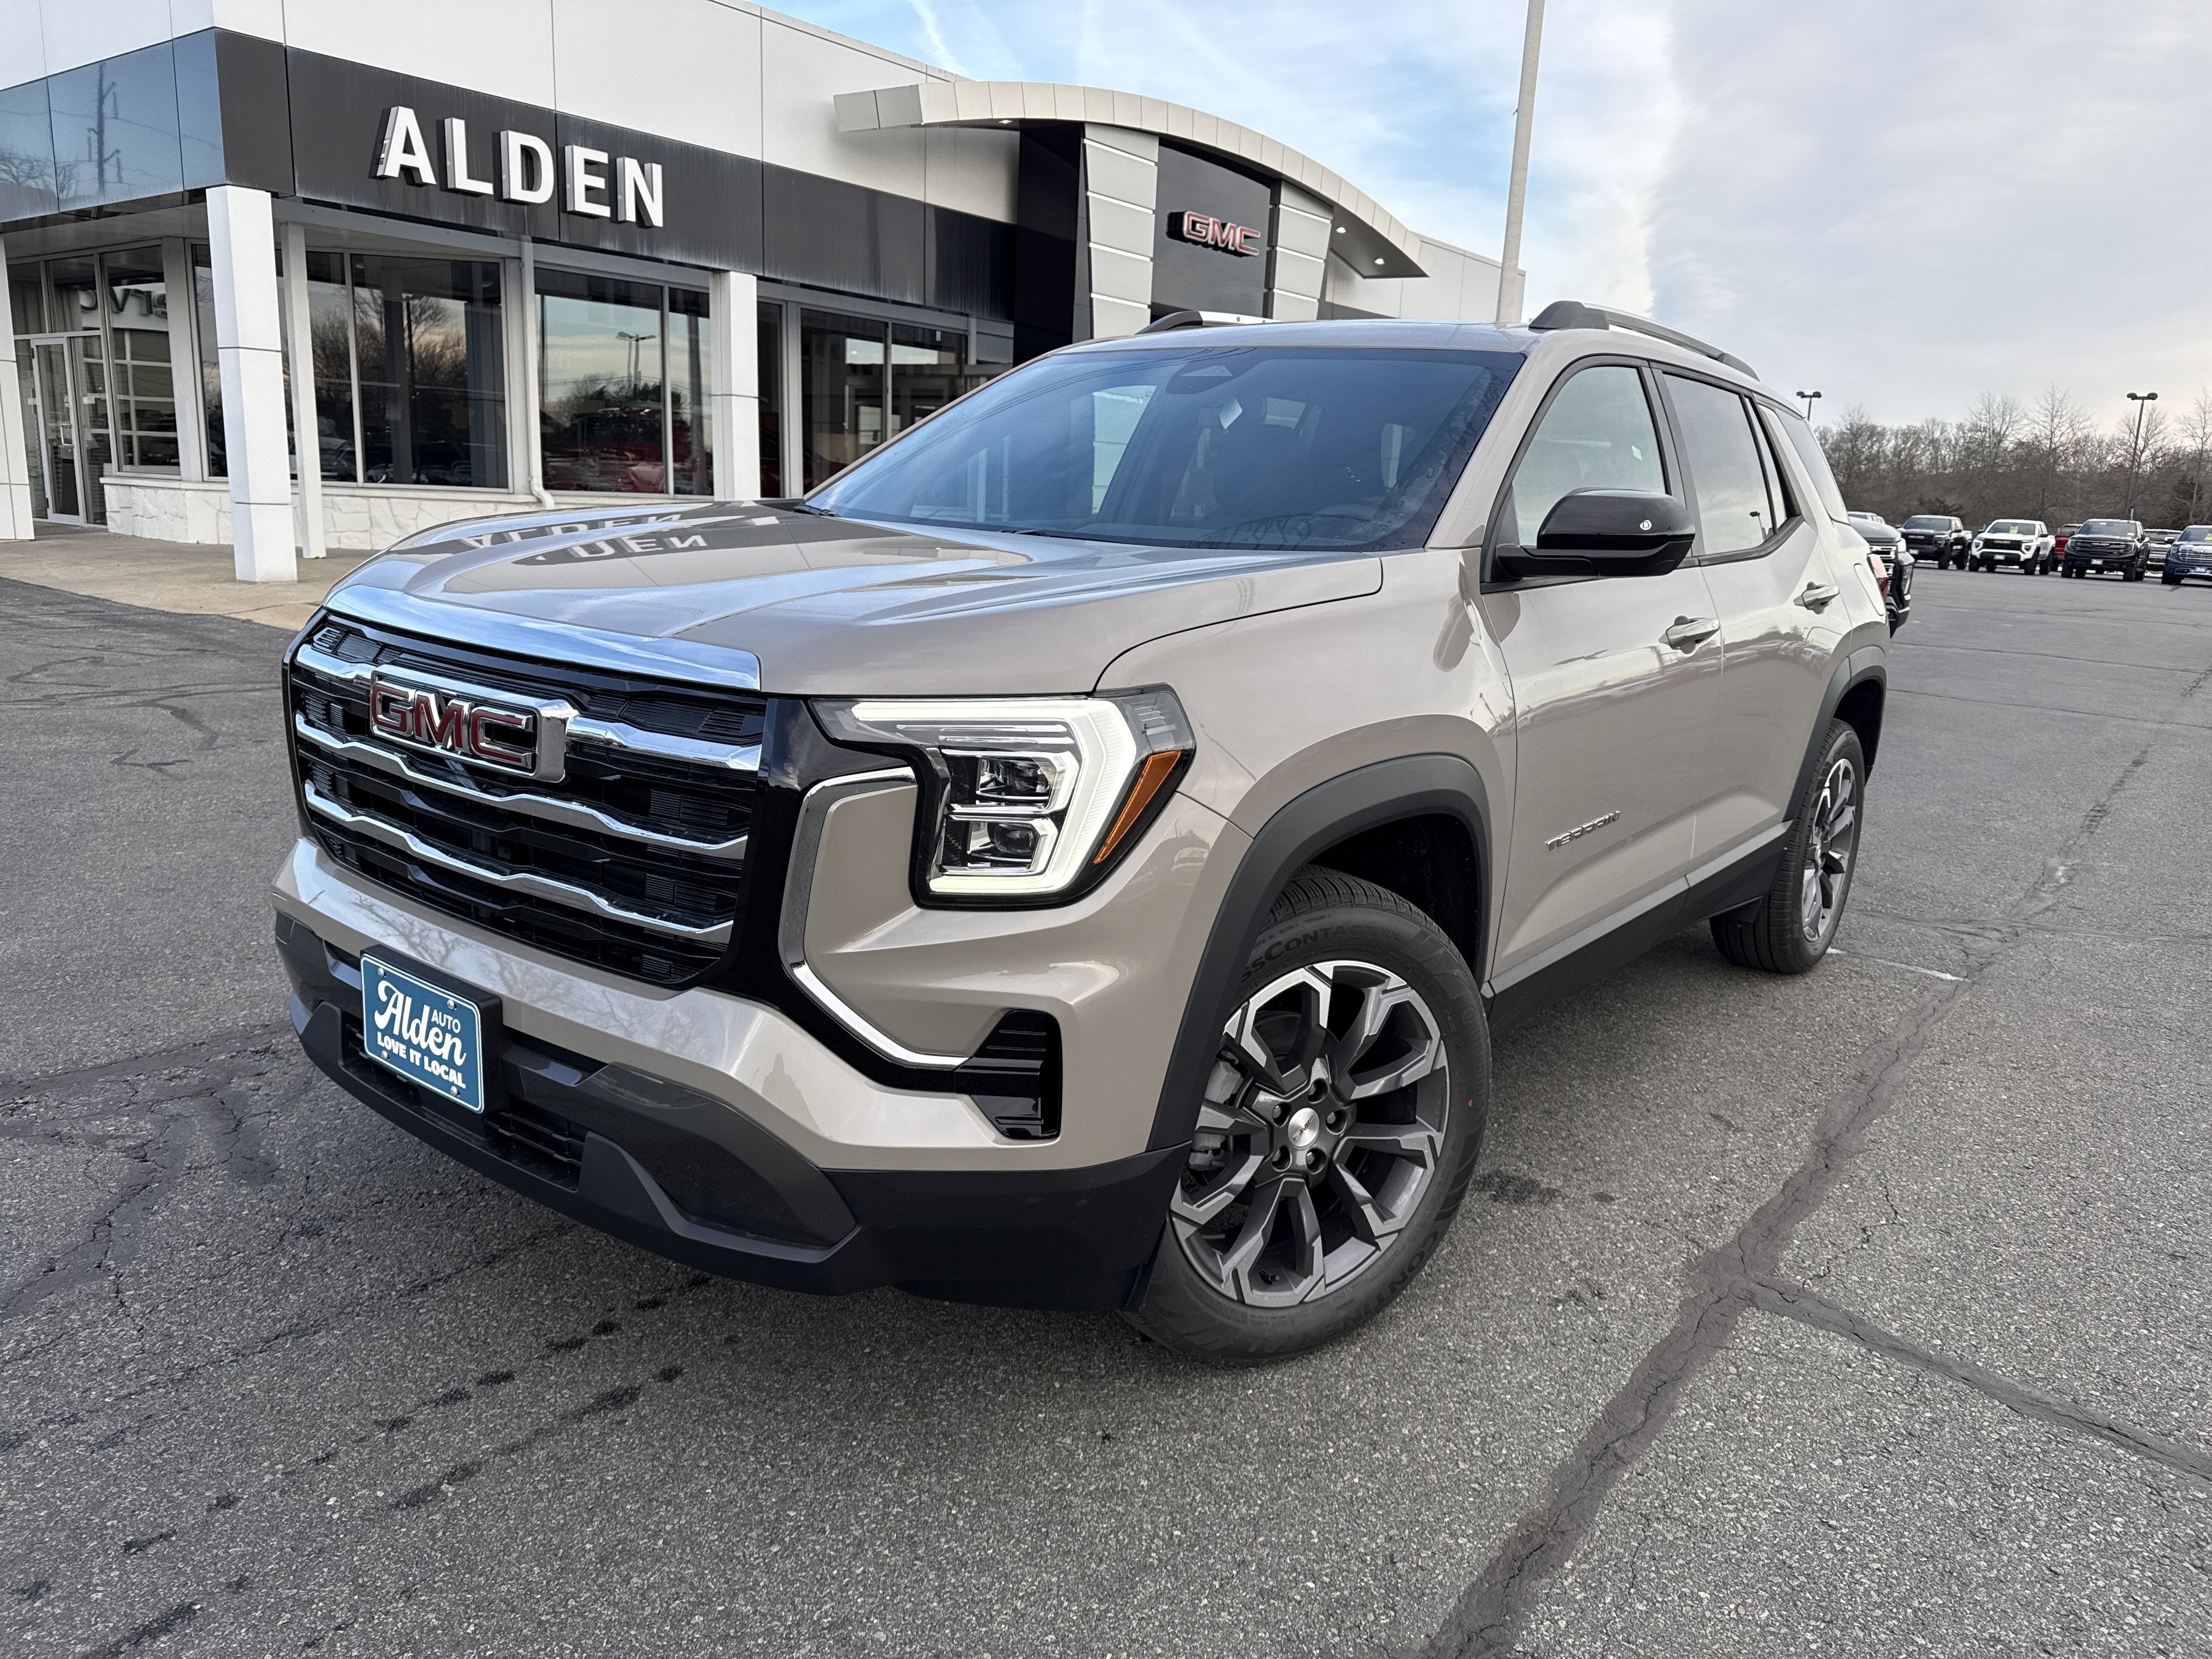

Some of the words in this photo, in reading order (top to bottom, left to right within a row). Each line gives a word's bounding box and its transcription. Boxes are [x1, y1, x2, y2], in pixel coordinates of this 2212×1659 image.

[377, 106, 663, 227] ALDEN
[1183, 211, 1261, 256] GMC
[370, 680, 533, 769] GMC
[1545, 810, 1620, 851] TERRAIN
[374, 980, 466, 1066] Alden
[431, 1009, 461, 1034] AUTO
[377, 1031, 407, 1059] LOVE
[409, 1048, 421, 1066] IT
[424, 1056, 466, 1089] LOCAL
